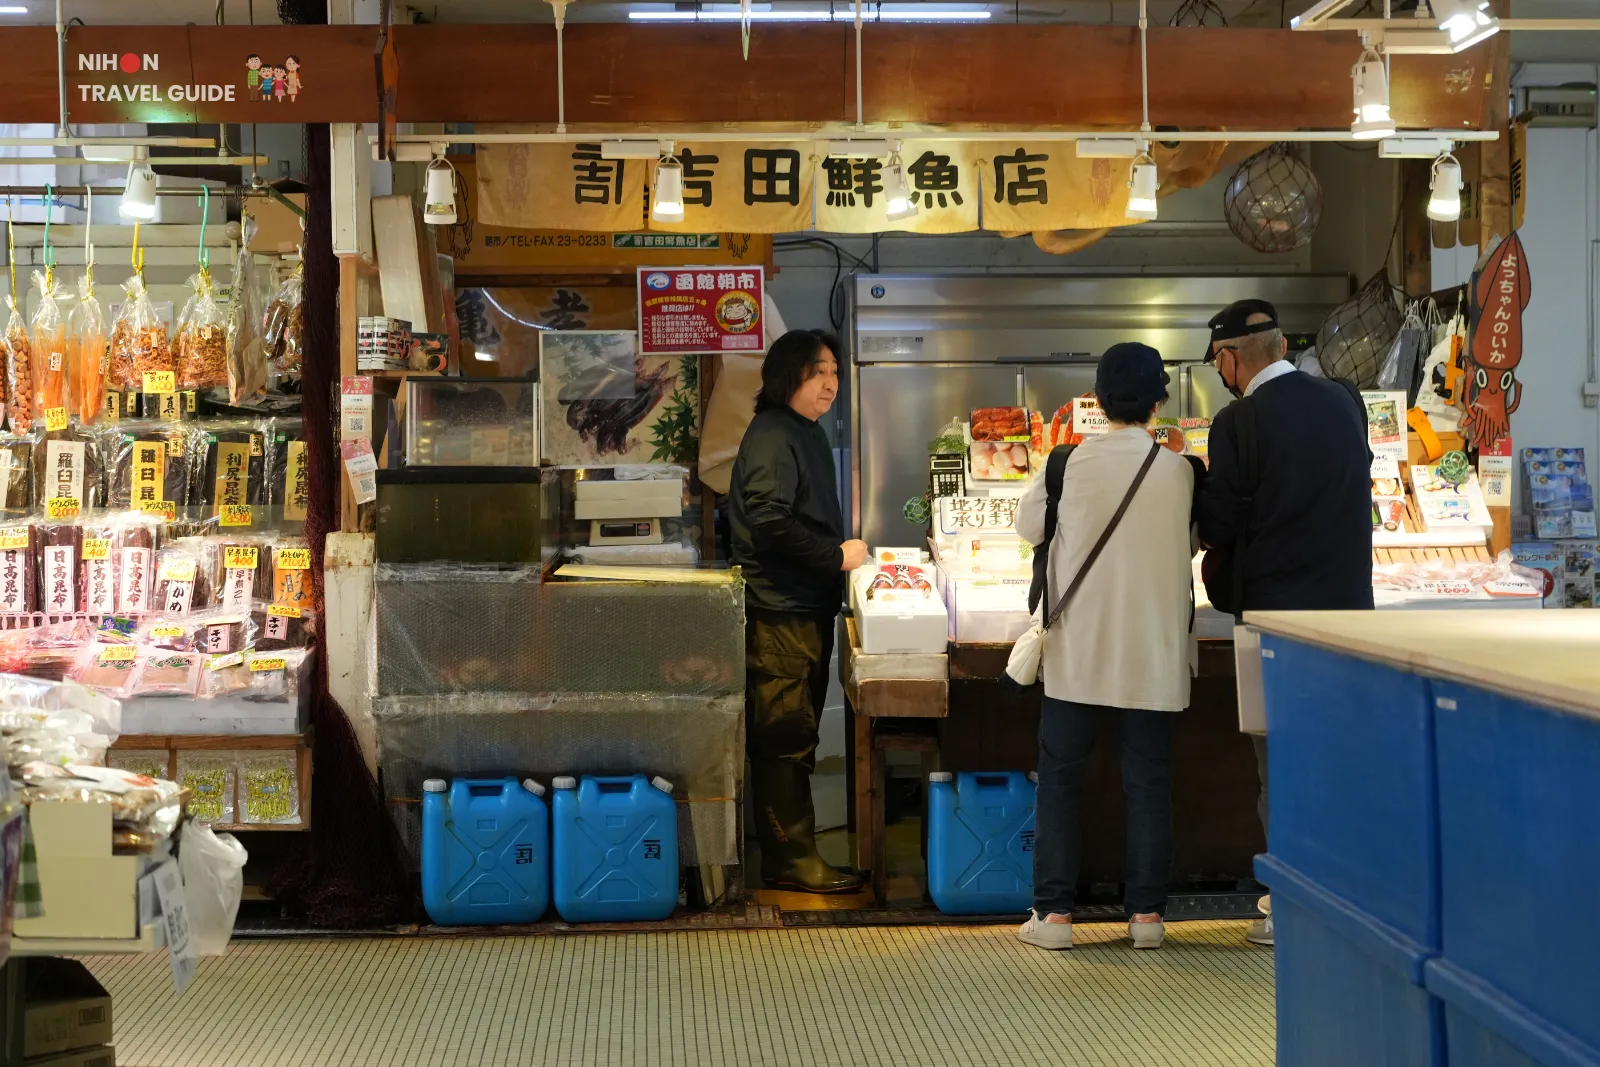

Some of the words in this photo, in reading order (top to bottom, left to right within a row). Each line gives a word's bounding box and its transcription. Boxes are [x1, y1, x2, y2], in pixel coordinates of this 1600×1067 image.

[557, 235, 607, 247] 23-0233
[675, 272, 755, 290] 函館朝市
[1489, 253, 1517, 364] よっちゃんのいか
[88, 547, 108, 557] 400
[230, 557, 254, 566] 400
[4, 550, 18, 608] 日高昆布
[53, 550, 67, 608] 日高昆布
[128, 551, 143, 607] 日高昆布
